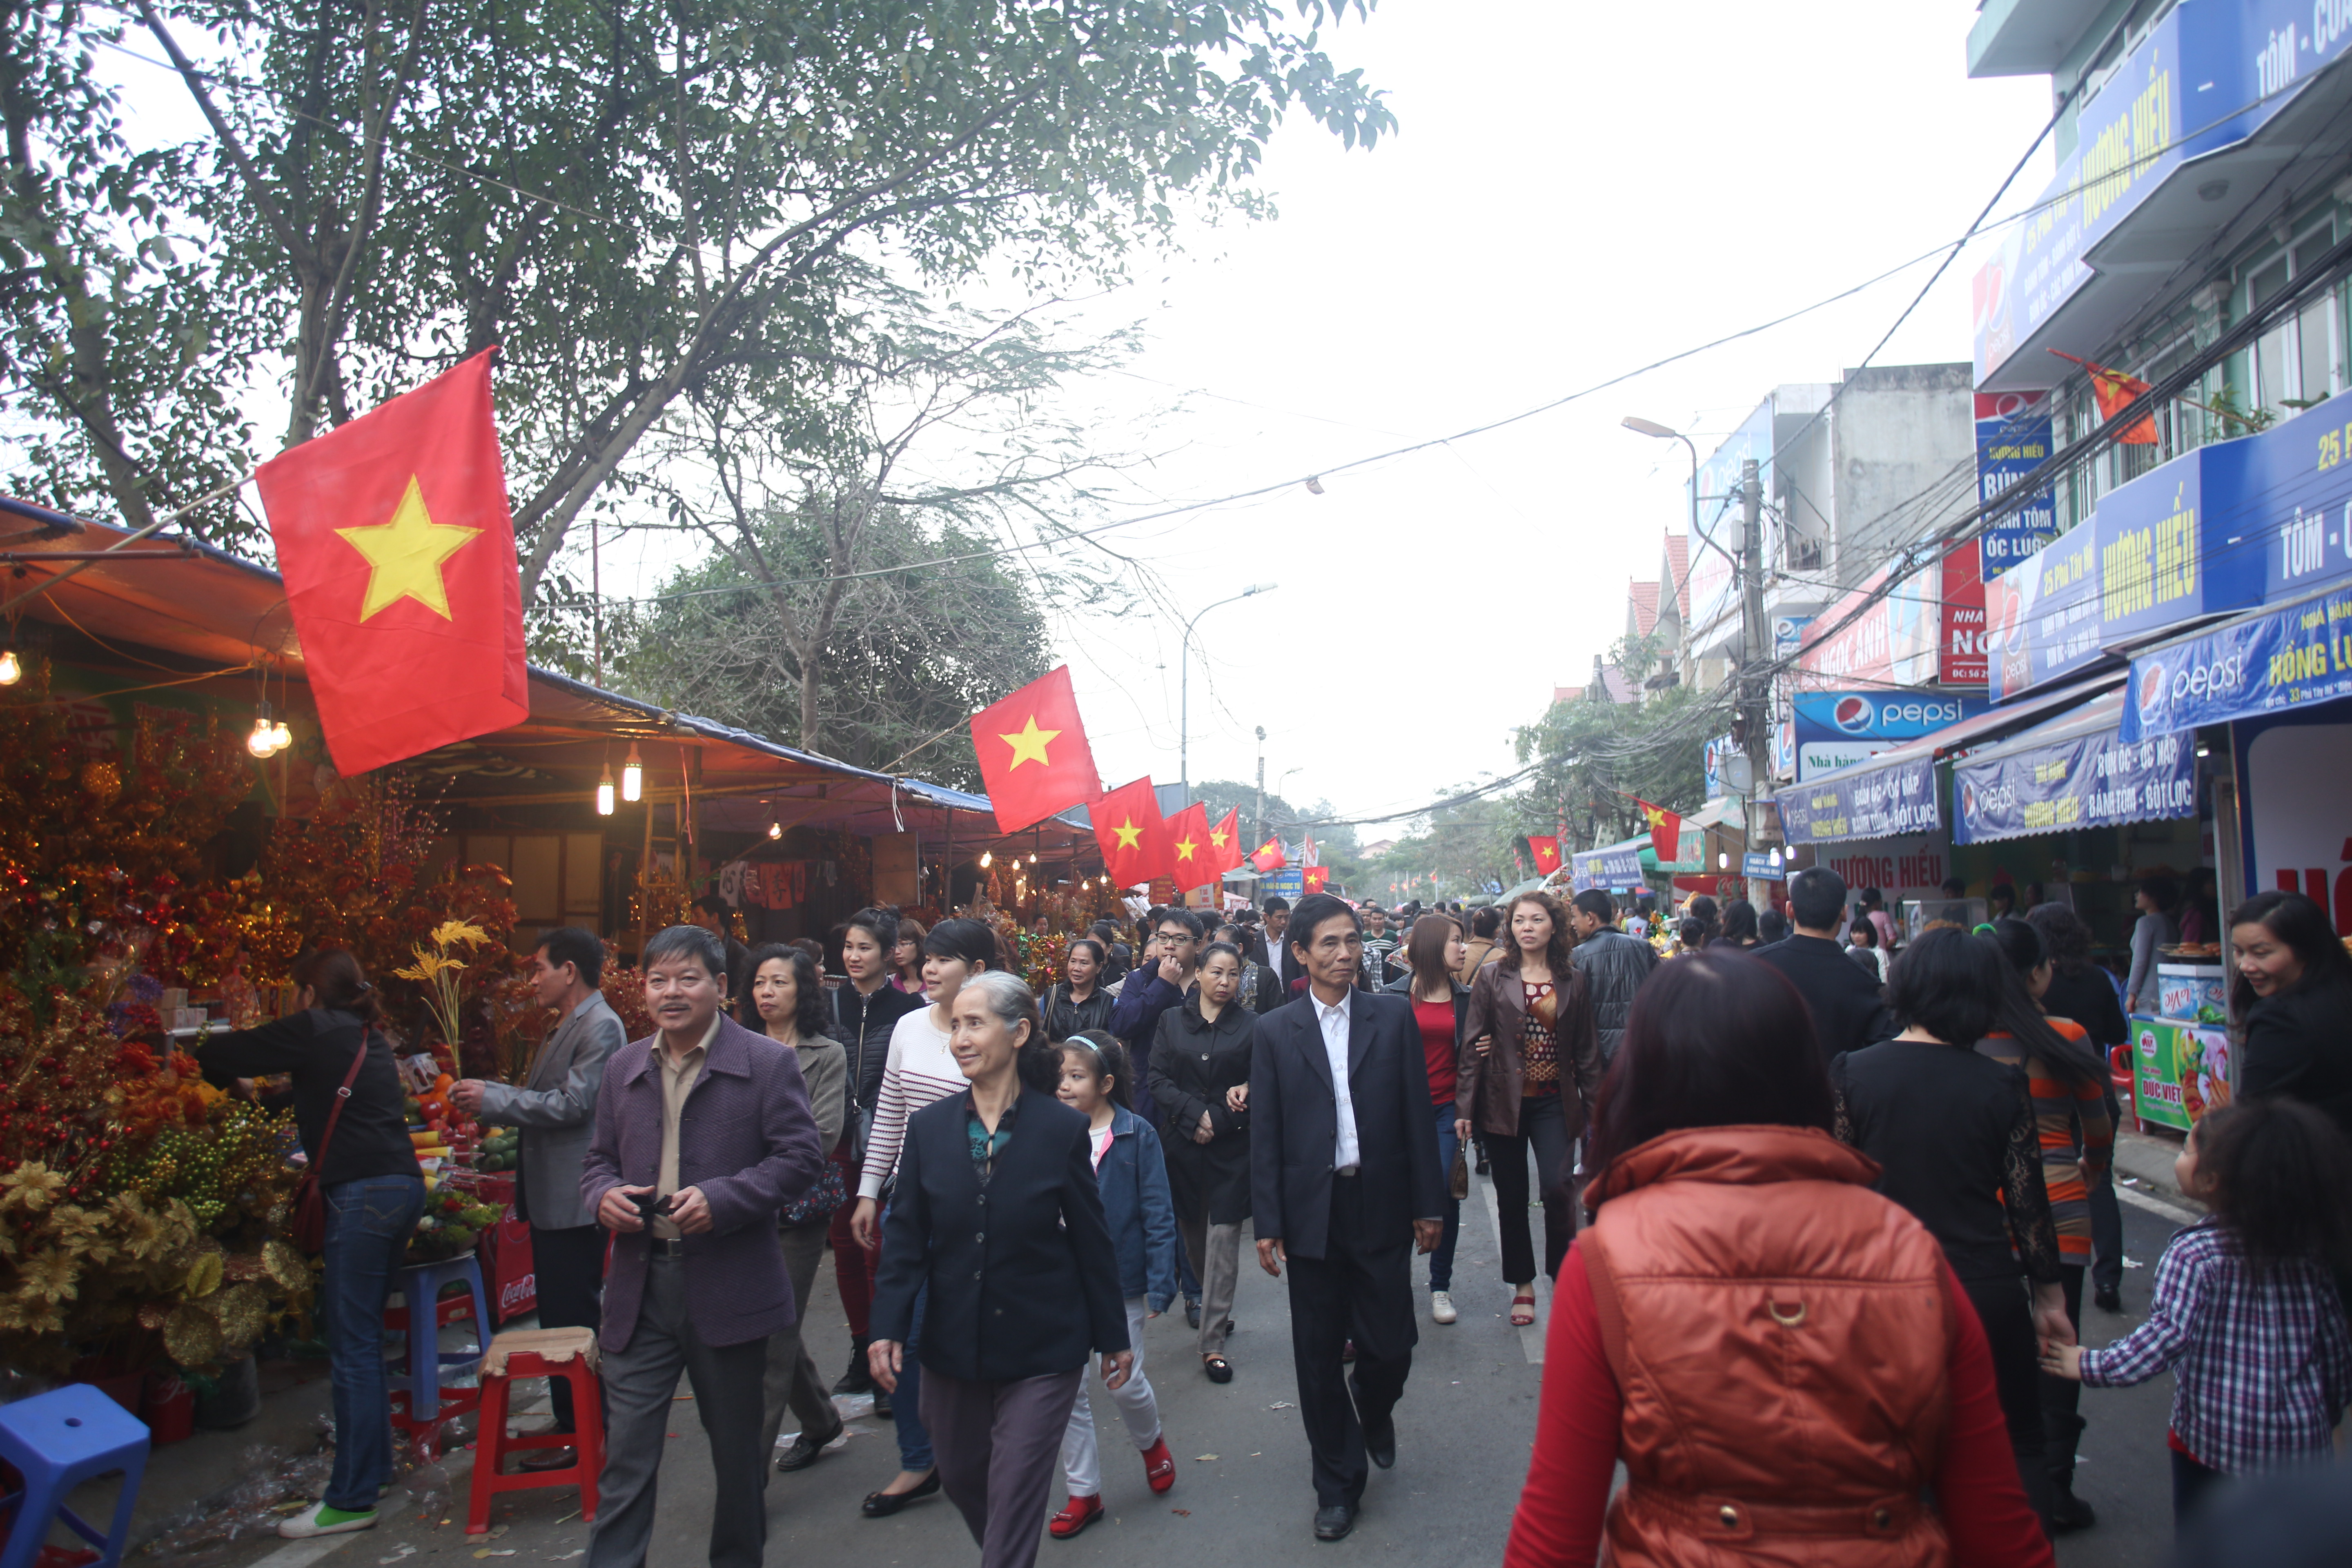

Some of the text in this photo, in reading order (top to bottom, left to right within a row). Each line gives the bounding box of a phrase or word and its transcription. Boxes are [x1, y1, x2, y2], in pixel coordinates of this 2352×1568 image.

[2256, 22, 2296, 107] TÔM
[2083, 47, 2170, 229] HƯƠNG HIẾU
[2023, 440, 2044, 459] HIẾU
[2318, 430, 2340, 471] 25
[2023, 505, 2051, 528] TÔM
[1986, 532, 2008, 558] ỐC
[2103, 481, 2194, 622] HƯƠNG HIẾU
[2281, 507, 2323, 579] TÔM
[2044, 569, 2054, 597] 25
[2055, 555, 2069, 591] Phủ
[2069, 552, 2082, 581] Tây
[2301, 610, 2325, 630] NHÀ
[1820, 634, 1852, 690] NGỌC
[1855, 612, 1885, 670] ÁNH
[2006, 654, 2027, 683] pepsi
[2270, 640, 2327, 687] HỒNG
[2171, 646, 2242, 708] pepsi
[2290, 687, 2300, 702] 33
[1882, 699, 1963, 727] pepsi
[1808, 754, 1831, 768] Nhà
[2097, 747, 2116, 778] BÚN
[2118, 744, 2131, 773] ỐC
[2156, 733, 2178, 766] HẤP
[1901, 769, 1919, 796] HẤP
[1979, 779, 2016, 818] pepsi
[2089, 788, 2114, 819] BÁNH
[2116, 784, 2136, 814] TÔM
[2146, 778, 2166, 815] BỘT
[2168, 779, 2192, 813] LỌC
[1791, 804, 1808, 828] pepsi
[1914, 803, 1935, 828] LỌC
[2024, 787, 2078, 829] HƯƠNG HIẾU
[1280, 882, 1293, 891] NGỌC
[1294, 881, 1301, 889] TÚ
[1830, 843, 1942, 890] HƯƠNG HIẾU
[2143, 1078, 2181, 1106] ĐỨC VIỆT
